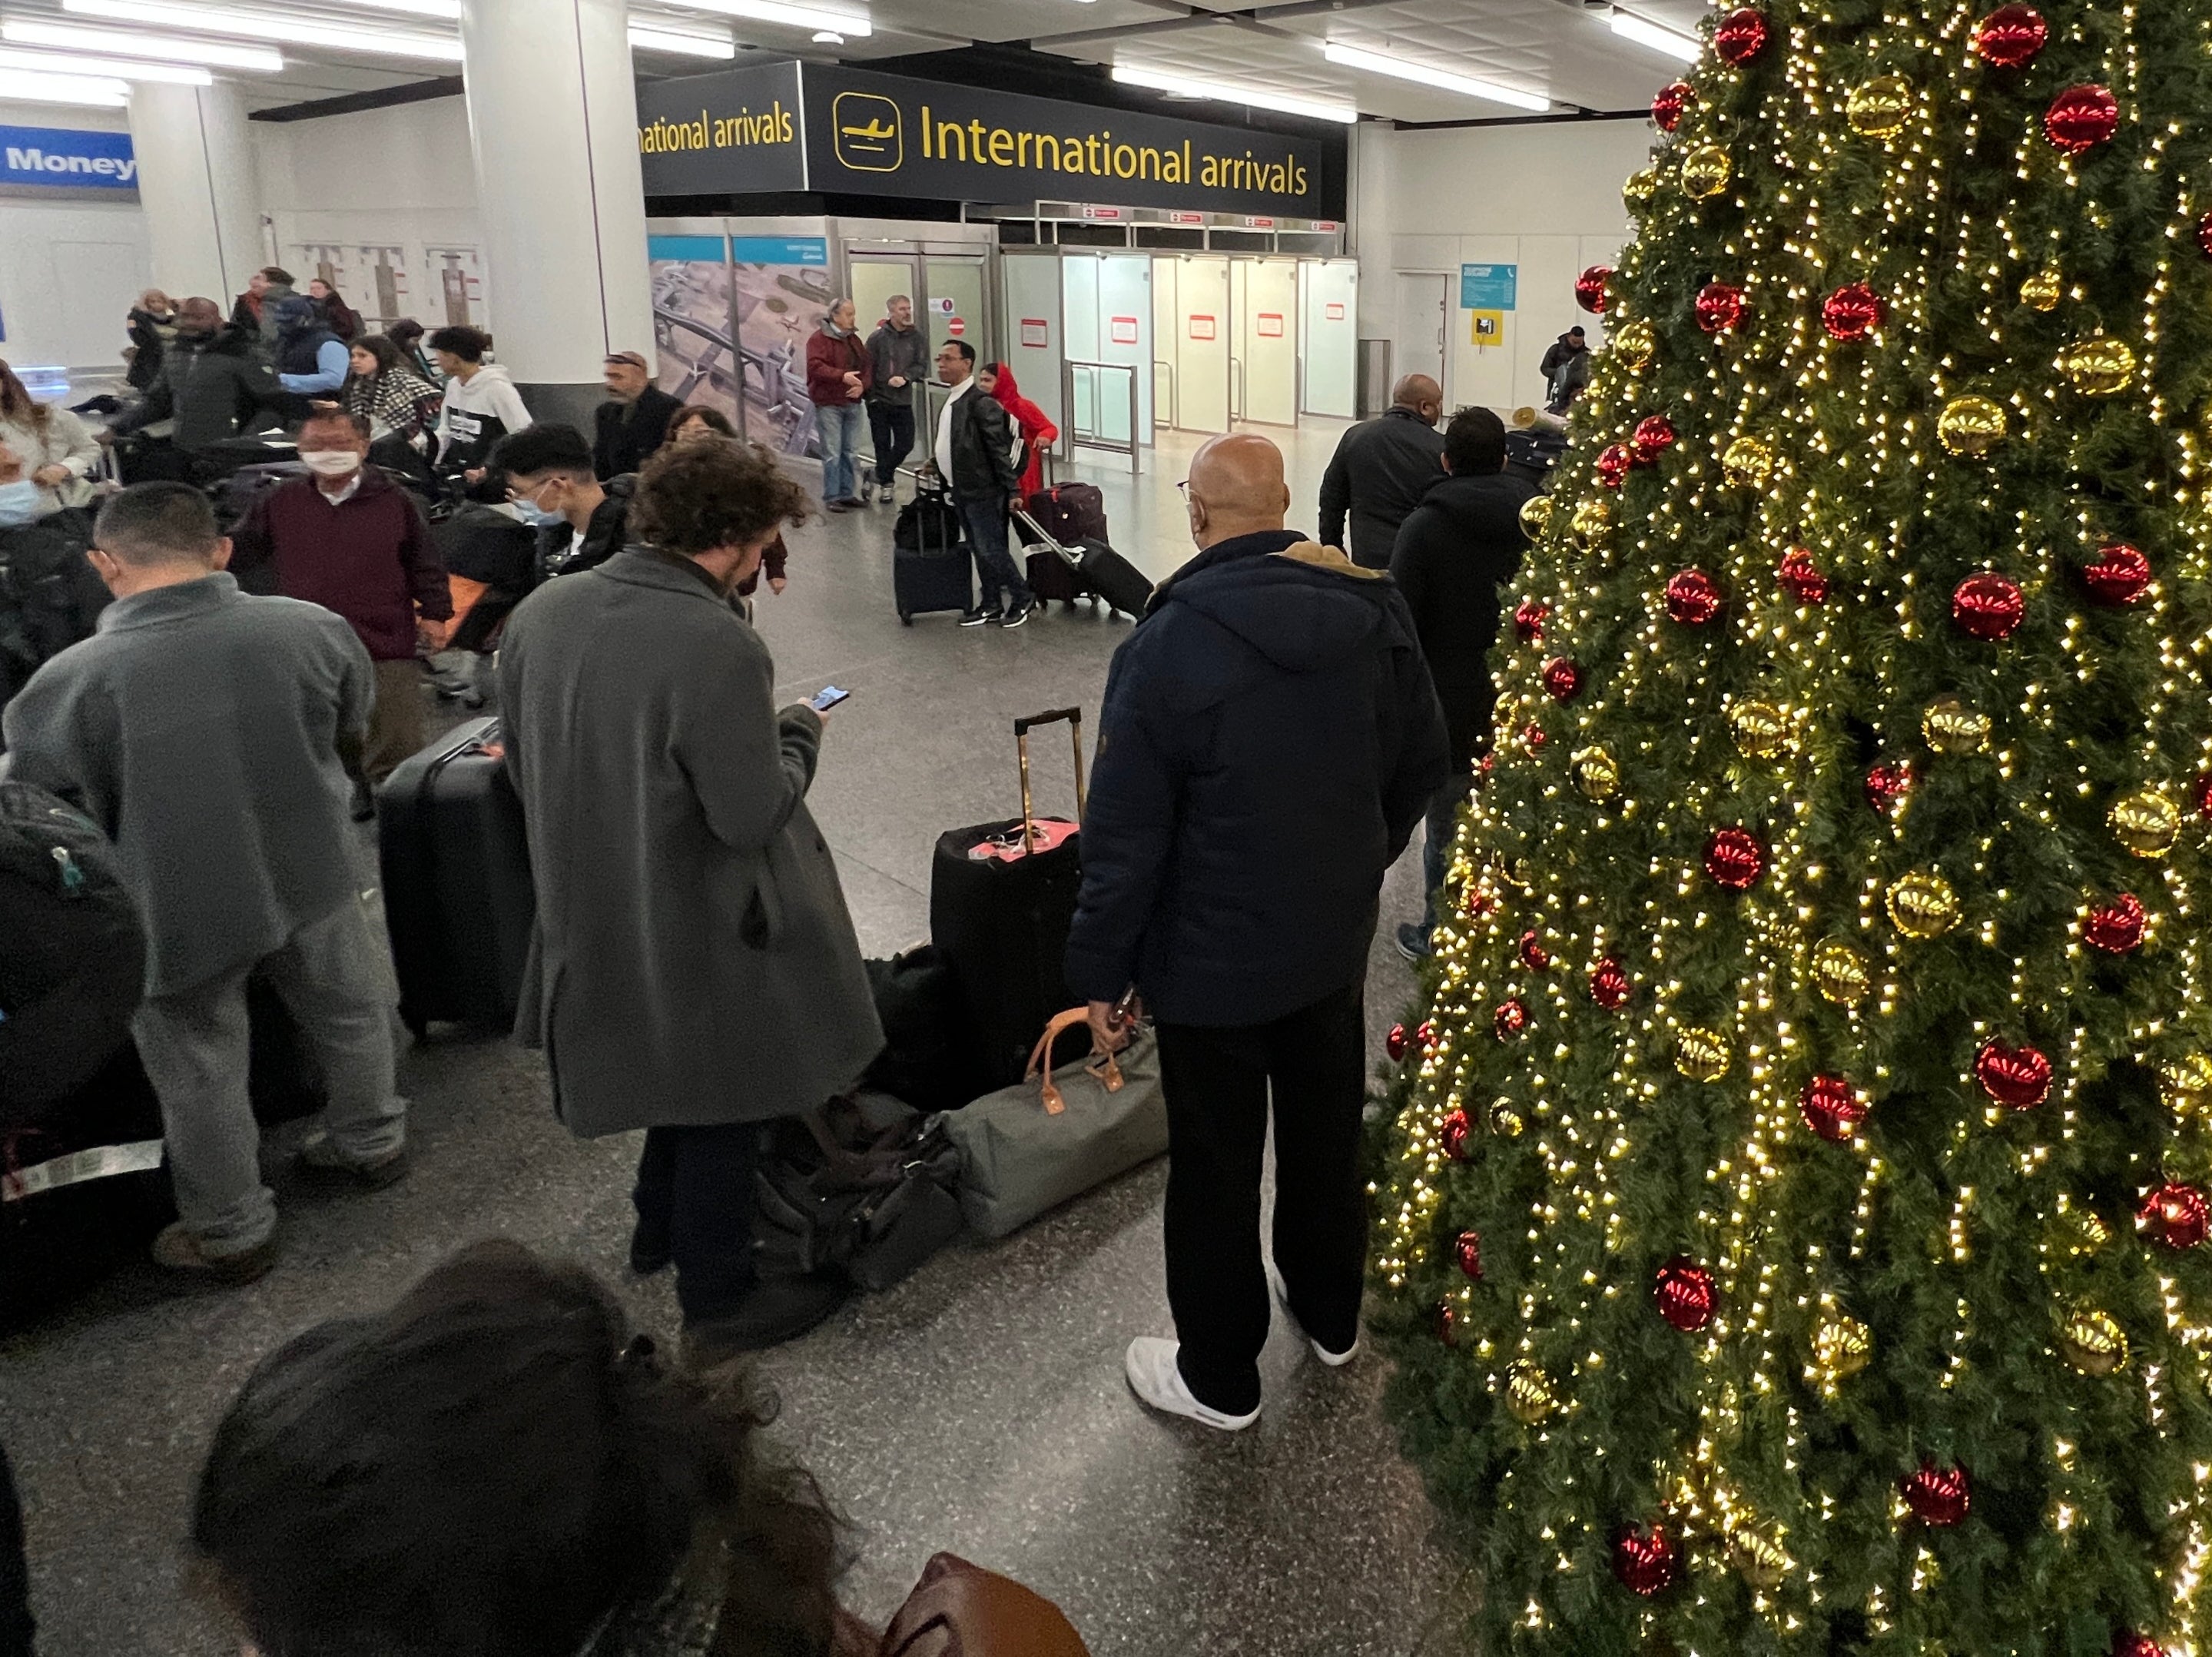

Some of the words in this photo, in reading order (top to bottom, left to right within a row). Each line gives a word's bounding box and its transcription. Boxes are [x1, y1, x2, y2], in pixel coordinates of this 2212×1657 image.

[714, 101, 793, 148] arrivals
[5, 147, 136, 181] Money
[921, 105, 1190, 184] International
[1200, 151, 1307, 196] arrivals
